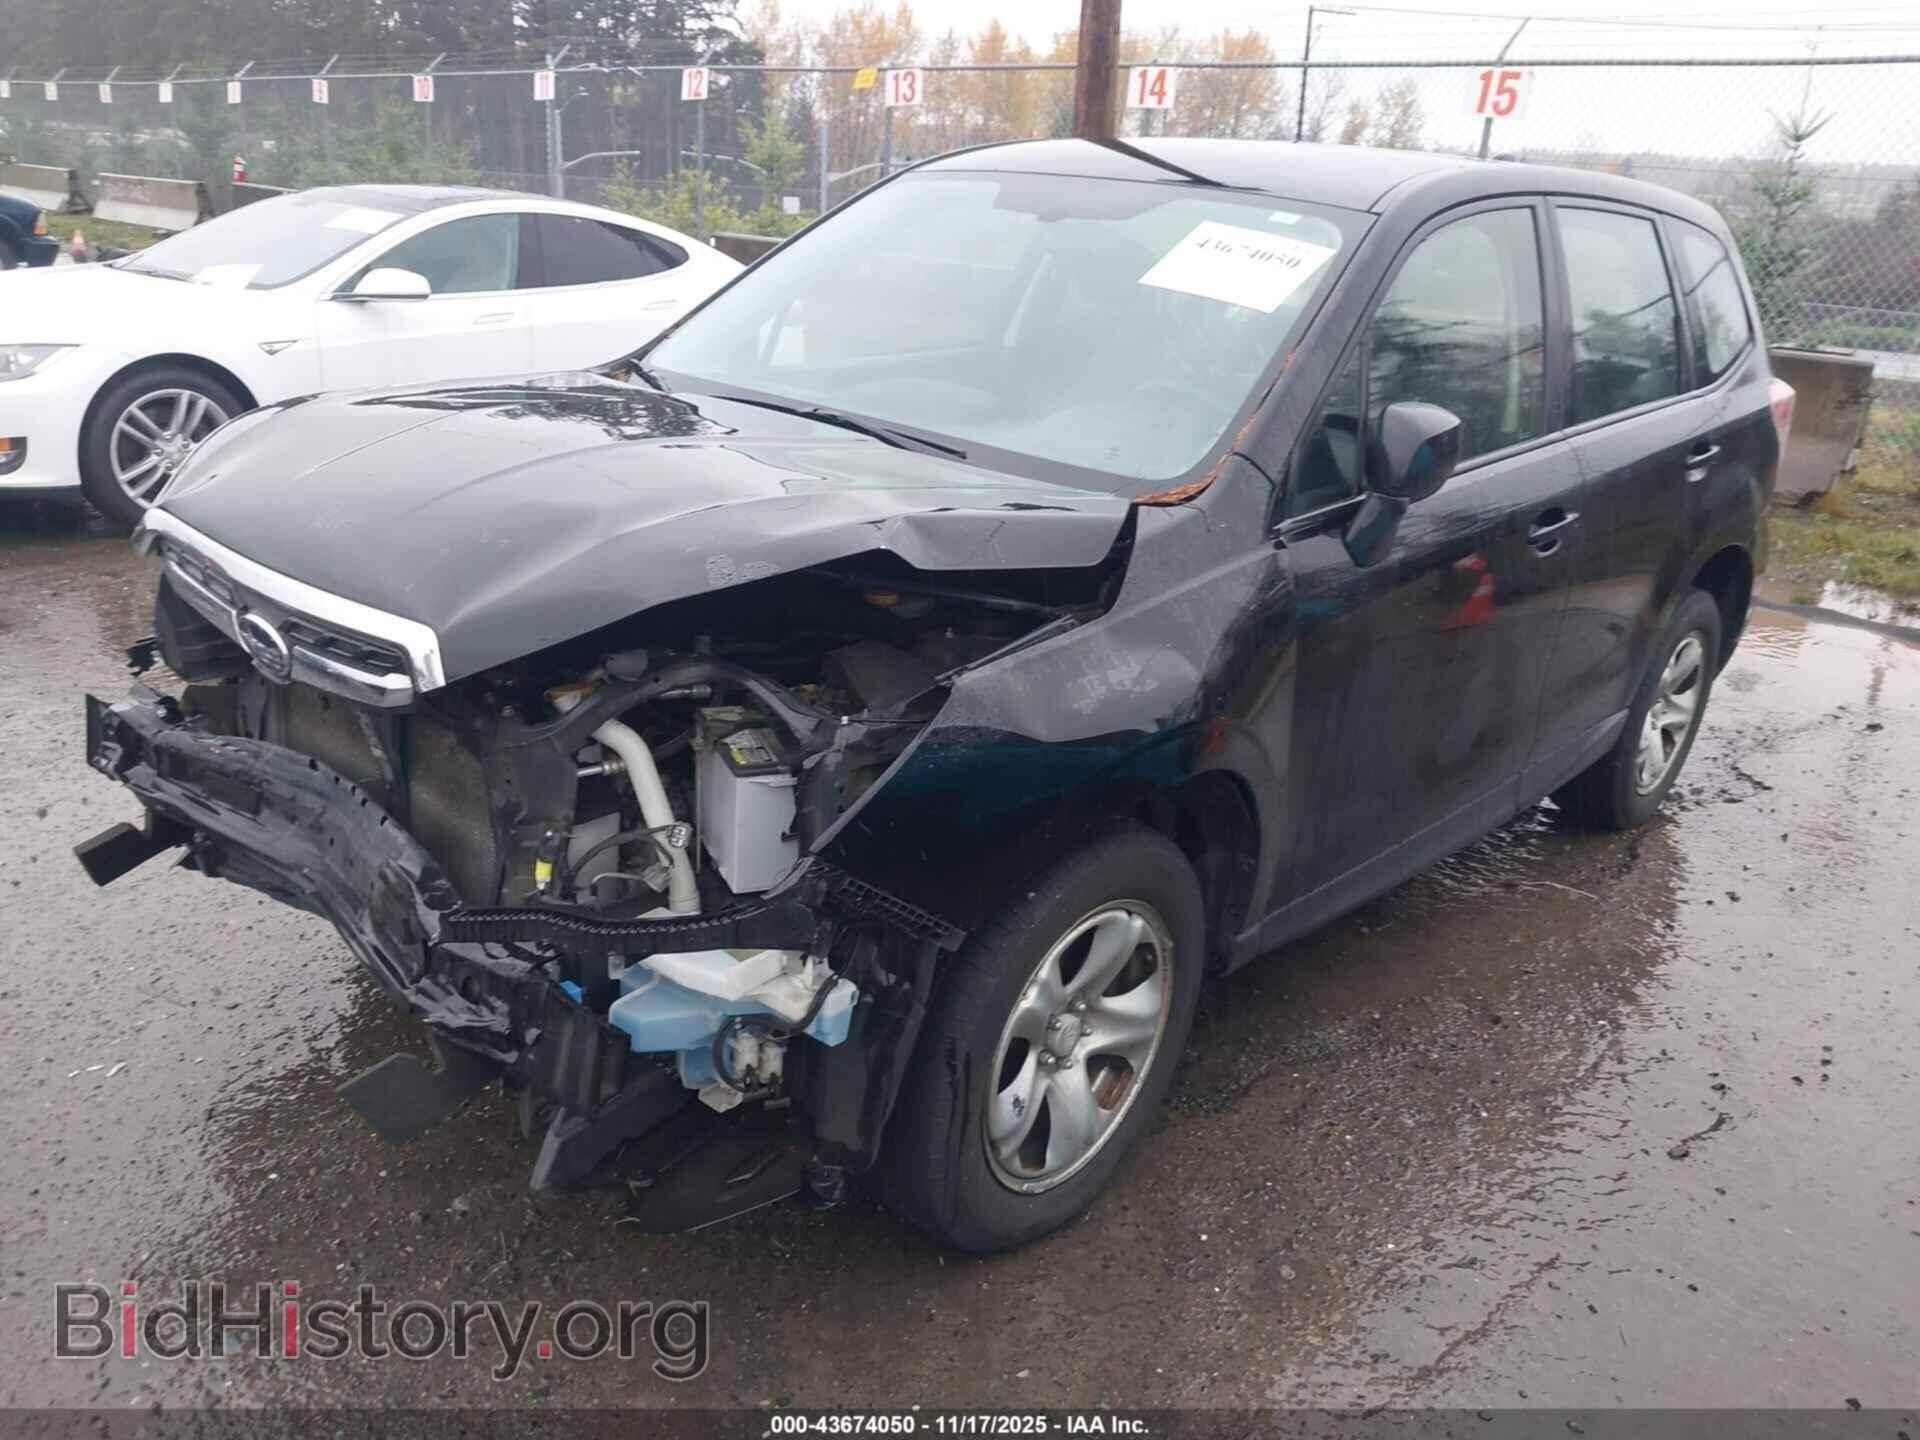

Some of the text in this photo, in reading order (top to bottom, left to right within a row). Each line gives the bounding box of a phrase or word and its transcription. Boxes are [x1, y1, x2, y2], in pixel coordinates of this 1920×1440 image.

[688, 70, 703, 97] 12
[893, 70, 916, 103] 13
[1138, 68, 1167, 105] 14
[1477, 70, 1521, 116] 15
[1194, 238, 1302, 269] 43674050
